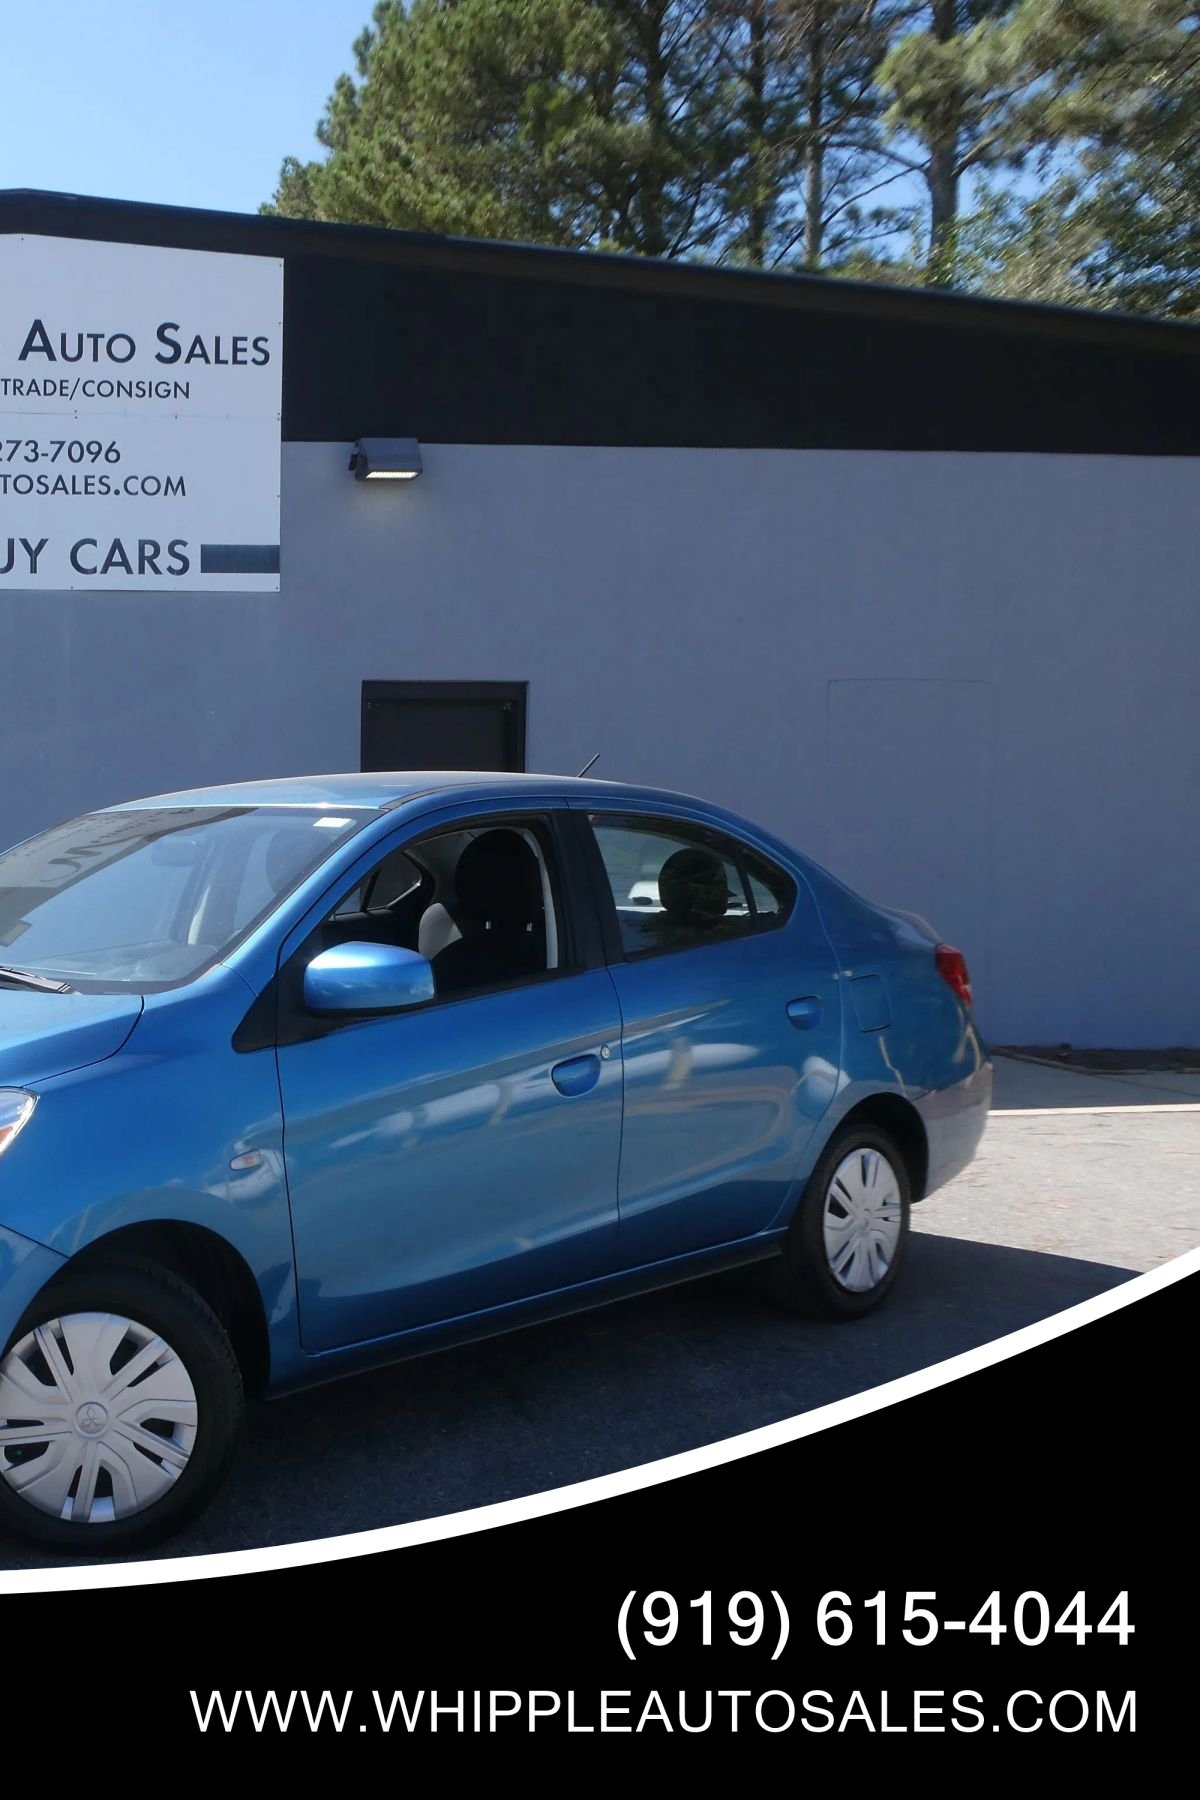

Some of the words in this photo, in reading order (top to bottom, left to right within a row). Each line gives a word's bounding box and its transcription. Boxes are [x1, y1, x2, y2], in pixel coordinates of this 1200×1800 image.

[17, 319, 137, 364] AUTO
[155, 322, 272, 366] SALES
[69, 538, 191, 577] CARS
